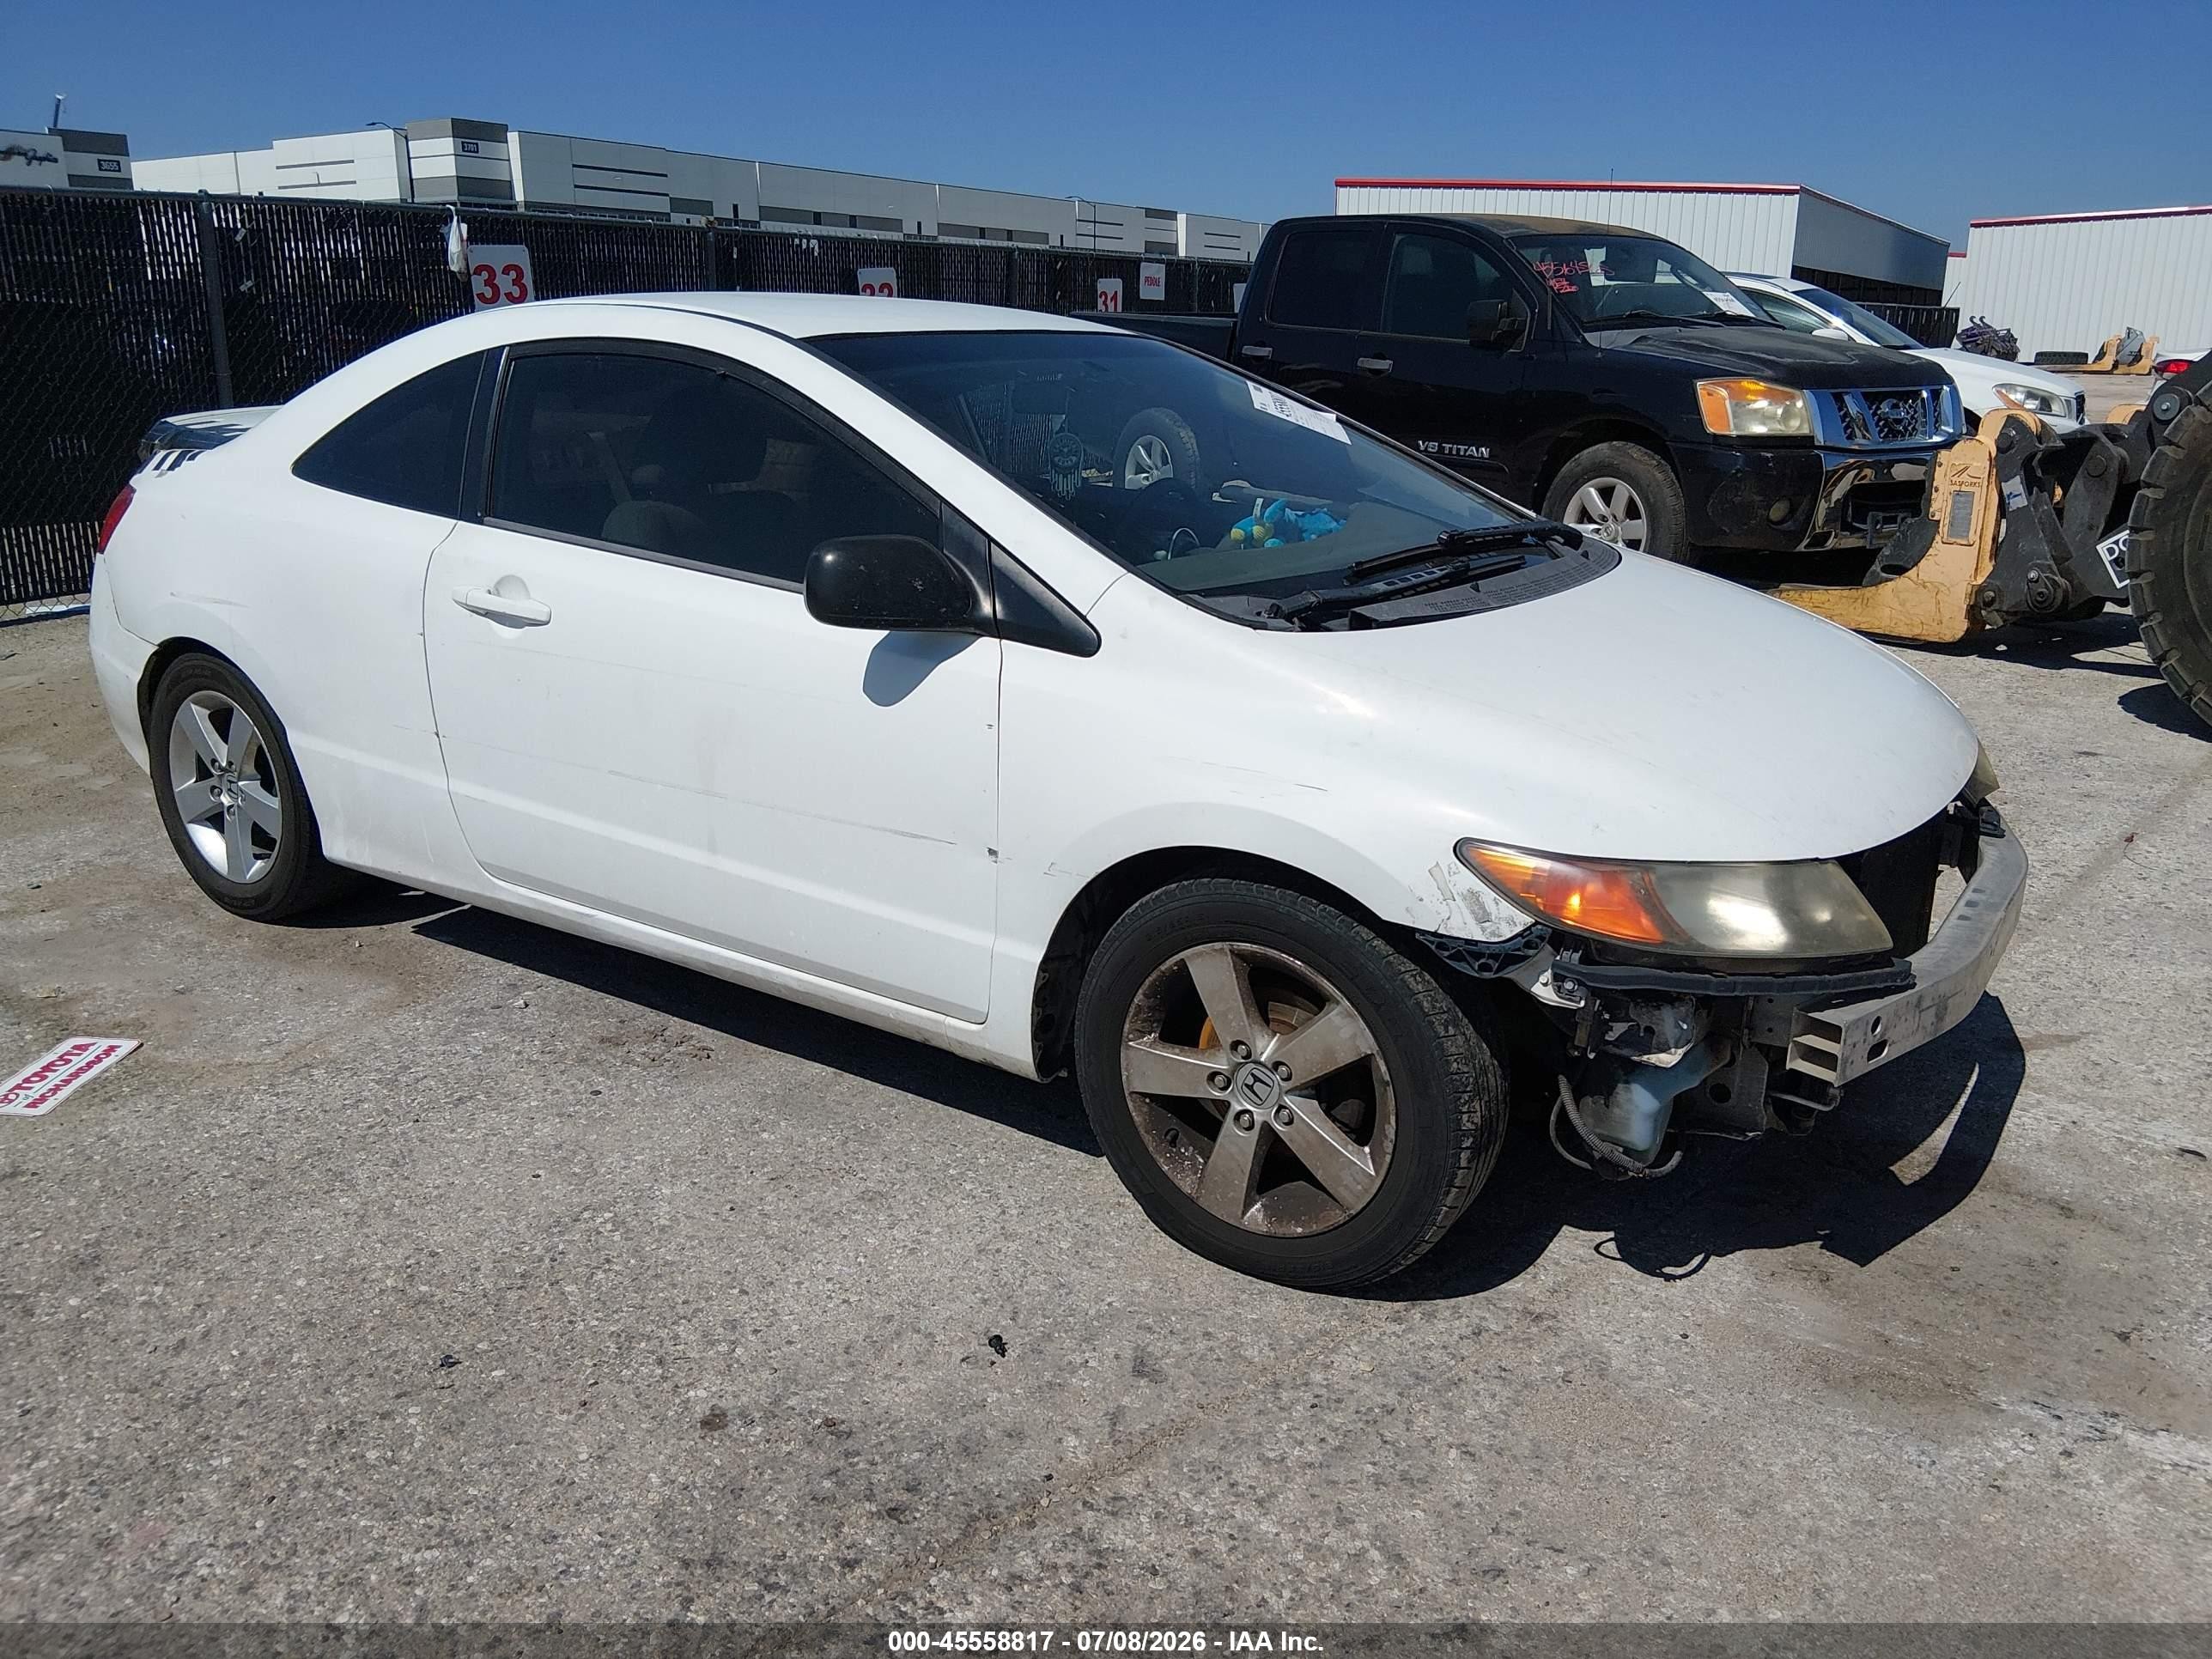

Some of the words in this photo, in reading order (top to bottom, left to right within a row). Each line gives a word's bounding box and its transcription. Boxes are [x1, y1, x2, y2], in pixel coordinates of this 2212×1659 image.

[464, 143, 477, 152] 3701
[472, 264, 528, 305] 33
[1098, 290, 1119, 313] 31
[1442, 443, 1490, 459] TITAN
[1950, 479, 1981, 489] SASFORKS
[7, 1042, 98, 1092] TOYOTA
[22, 1044, 123, 1109] RICHARDSON
